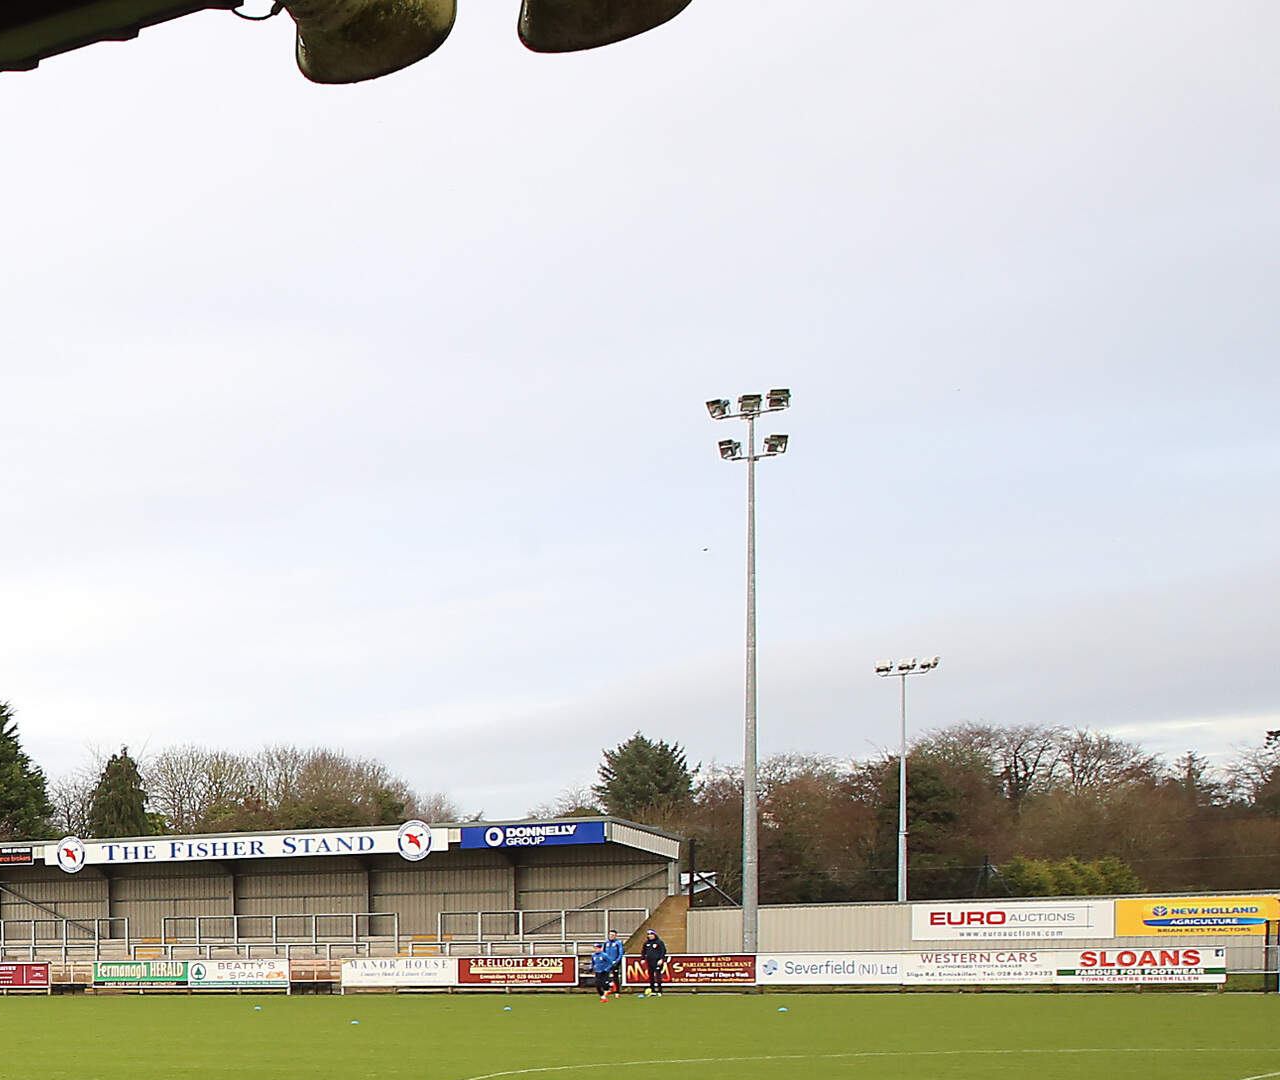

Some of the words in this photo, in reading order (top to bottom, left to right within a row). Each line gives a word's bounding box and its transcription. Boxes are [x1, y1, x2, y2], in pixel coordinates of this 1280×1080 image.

[506, 825, 577, 837] DONNELLY
[506, 836, 546, 846] GROUP
[102, 844, 157, 861] THE
[169, 841, 265, 858] FISHER
[282, 836, 375, 855] STAND
[1171, 907, 1198, 915] NEW
[1201, 906, 1259, 915] HOLLAND
[930, 911, 1007, 925] EURO
[1009, 912, 1076, 922] AUCTIONS
[1169, 917, 1239, 925] AGRICULTURE
[958, 929, 1064, 938] www.euroauctions.com
[536, 958, 563, 967] SONS
[920, 953, 990, 964] WESTERN
[996, 952, 1038, 962] CARS
[1080, 950, 1201, 967] SLOANS
[217, 962, 276, 970] BEATTY'S
[350, 960, 396, 969] MANOR
[406, 960, 449, 969] HOUSE
[784, 961, 855, 975] Severfield
[858, 964, 879, 976] (NI)
[880, 964, 898, 975] Ltd
[98, 962, 148, 978] Fermanagh
[150, 962, 184, 977] HERALD
[1075, 968, 1119, 976] FAMOUS
[1120, 968, 1141, 976] FOR
[1144, 968, 1206, 976] FOOTWEAR
[230, 971, 264, 979] SPAR
